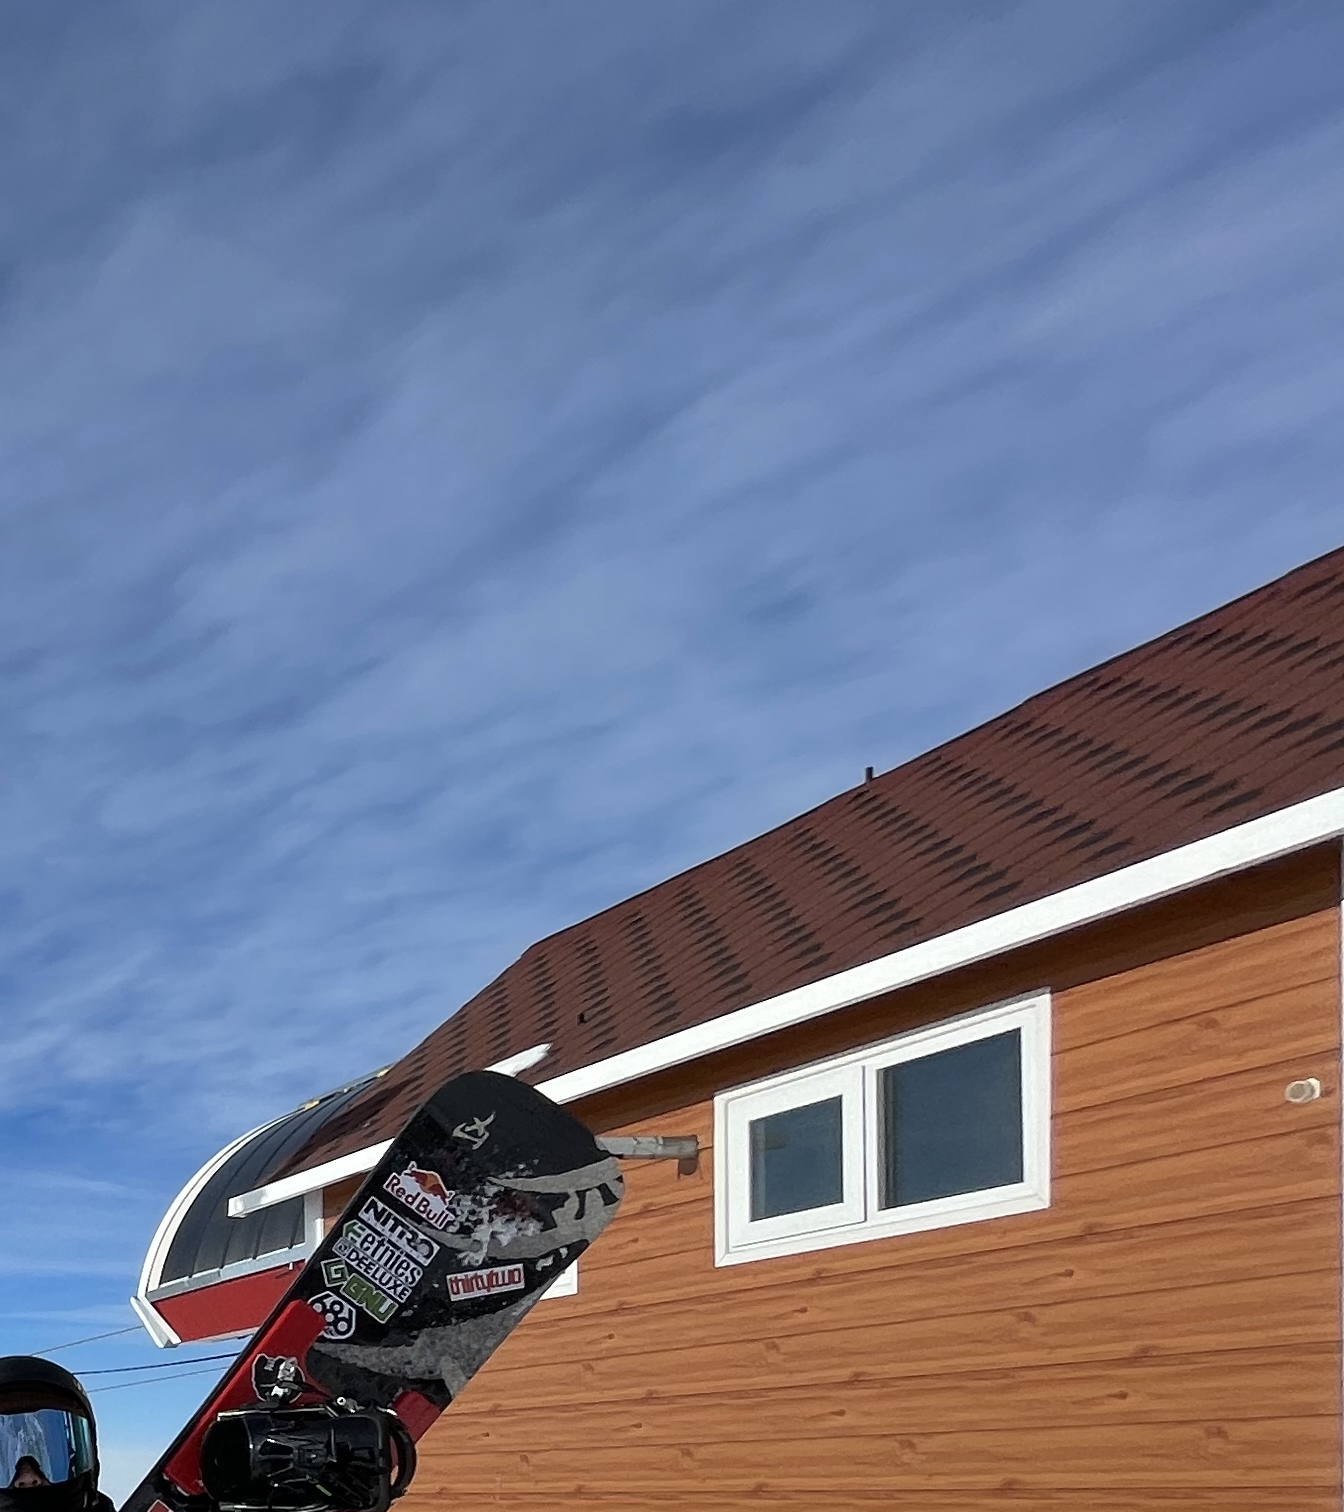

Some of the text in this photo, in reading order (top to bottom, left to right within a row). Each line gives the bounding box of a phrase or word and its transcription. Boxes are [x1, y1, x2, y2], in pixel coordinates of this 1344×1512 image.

[364, 1200, 435, 1260] NITRO
[346, 1247, 410, 1303] DEELUXE
[359, 1233, 421, 1286] etnies
